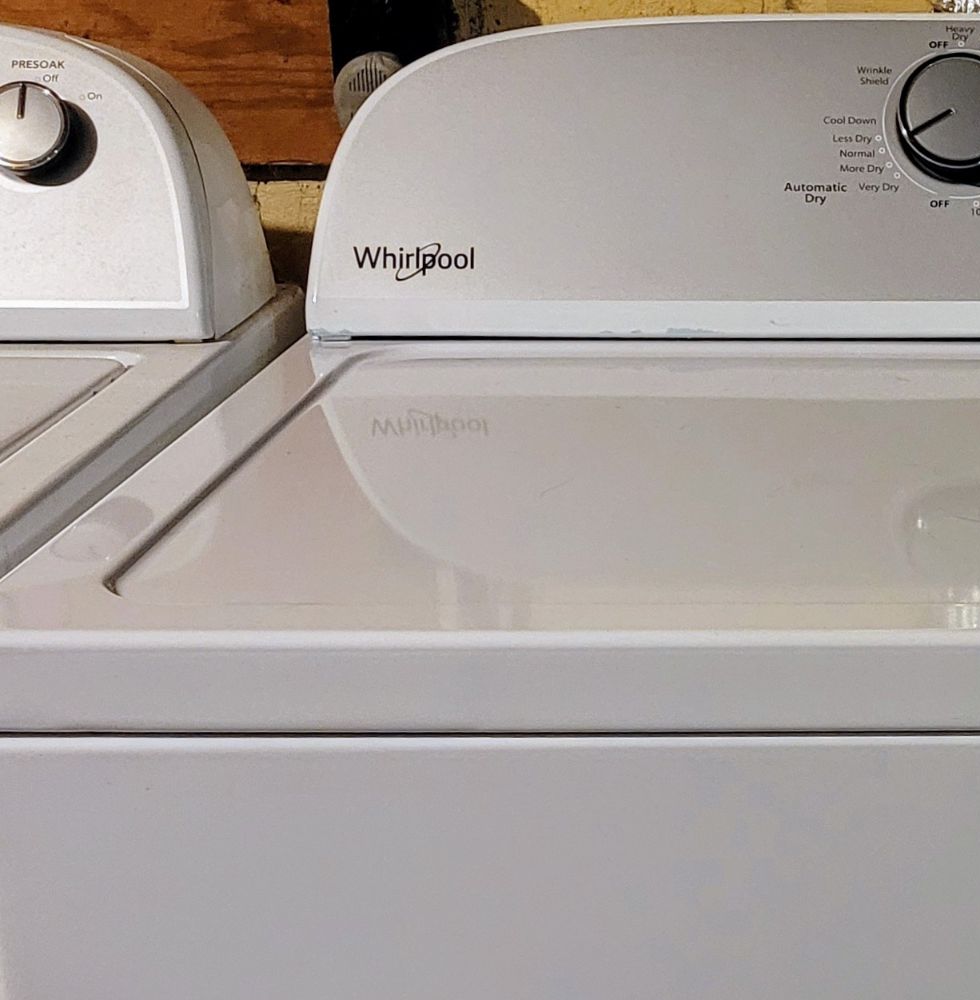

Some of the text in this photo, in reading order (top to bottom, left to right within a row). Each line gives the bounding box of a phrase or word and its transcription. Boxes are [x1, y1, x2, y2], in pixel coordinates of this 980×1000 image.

[945, 25, 976, 34] Heavy
[952, 32, 969, 42] Dry
[928, 40, 949, 49] OFF
[11, 60, 65, 69] PRESOAK
[856, 66, 893, 75] Wrinkle
[42, 74, 60, 83] Off
[860, 77, 889, 86] Shield
[87, 91, 103, 100] On
[823, 116, 877, 125] Cool Down
[832, 134, 873, 145] Less Dry
[839, 149, 876, 158] Normal
[840, 164, 885, 175] More Dry
[784, 182, 848, 193] Automatic
[859, 183, 900, 193] Very Dry
[804, 193, 827, 206] Dry
[929, 200, 950, 209] OFF
[353, 243, 475, 281] Whirlpool
